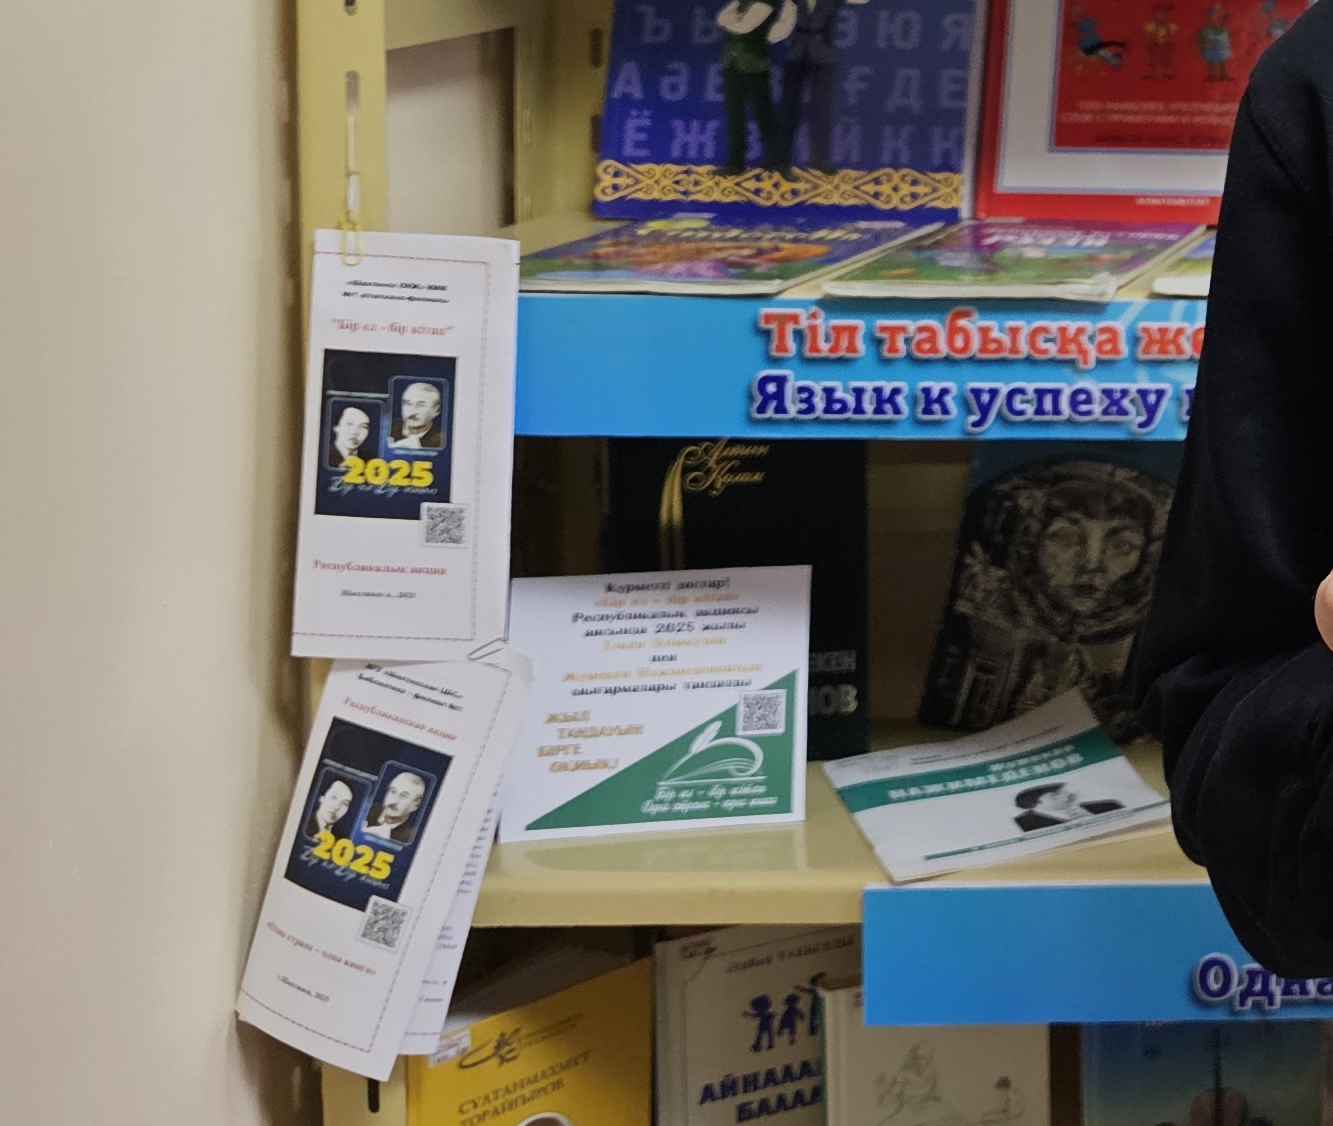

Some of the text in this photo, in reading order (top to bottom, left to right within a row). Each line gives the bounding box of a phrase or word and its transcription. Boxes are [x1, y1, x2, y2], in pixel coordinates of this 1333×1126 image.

[758, 310, 864, 357] Тіл
[876, 309, 1127, 368] табысқа
[753, 373, 1168, 431] Язык к успеху
[343, 457, 434, 488] 2025
[654, 621, 695, 634] 2025
[313, 831, 395, 881] 2025
